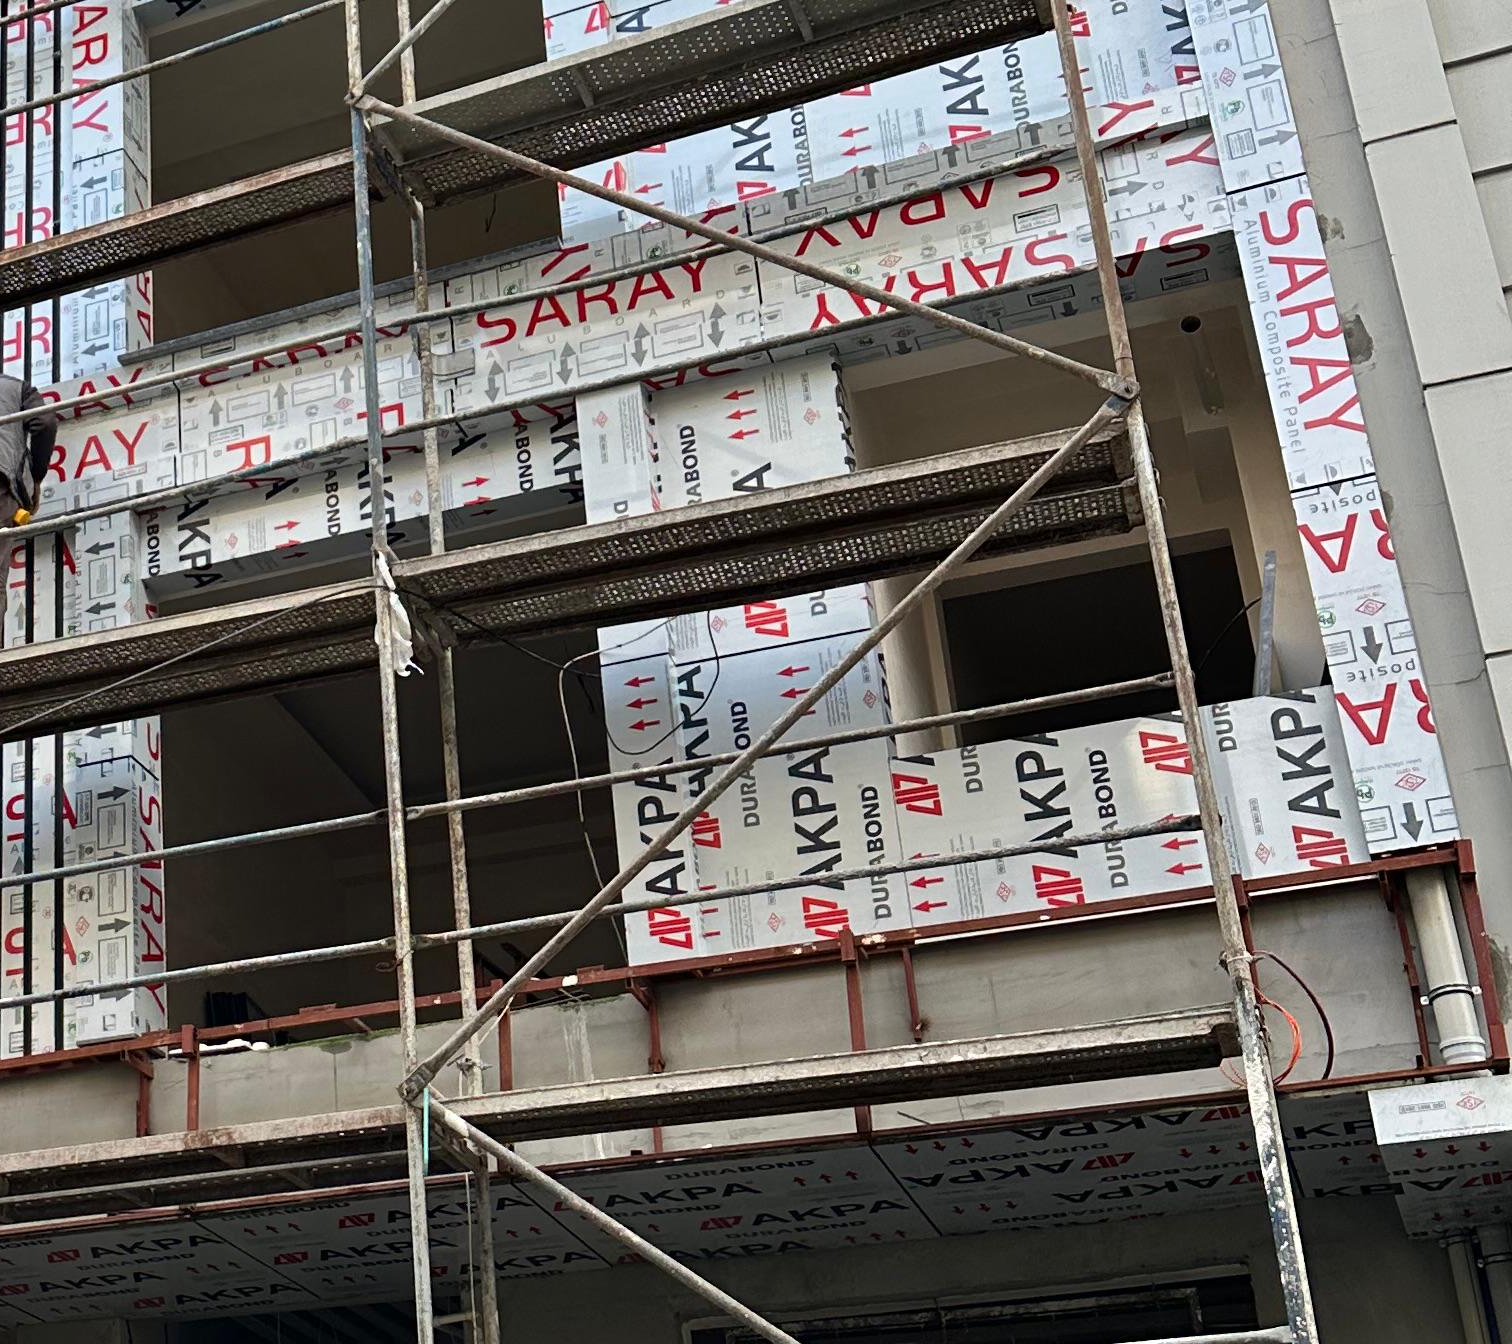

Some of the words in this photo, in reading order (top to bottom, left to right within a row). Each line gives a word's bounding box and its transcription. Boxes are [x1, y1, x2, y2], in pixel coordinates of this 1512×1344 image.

[475, 255, 710, 349] SARAY
[1259, 199, 1367, 433] SARAY
[1244, 219, 1270, 303] Aluminium
[1263, 309, 1291, 399] Composite
[1286, 406, 1306, 453] Panel
[1310, 489, 1377, 514] posite
[1347, 659, 1416, 683] posite
[788, 746, 845, 891] AKPA
[1089, 748, 1129, 888] DURABOND
[862, 786, 892, 920] DURABOND
[902, 1158, 1074, 1188] AKPA
[606, 1181, 761, 1209] AKPA
[1054, 1174, 1223, 1203] AKPA
[752, 1199, 909, 1226] AKPA
[90, 1234, 222, 1259] AKPA
[39, 1270, 165, 1293] AKPA
[175, 1282, 302, 1305] AKPA
